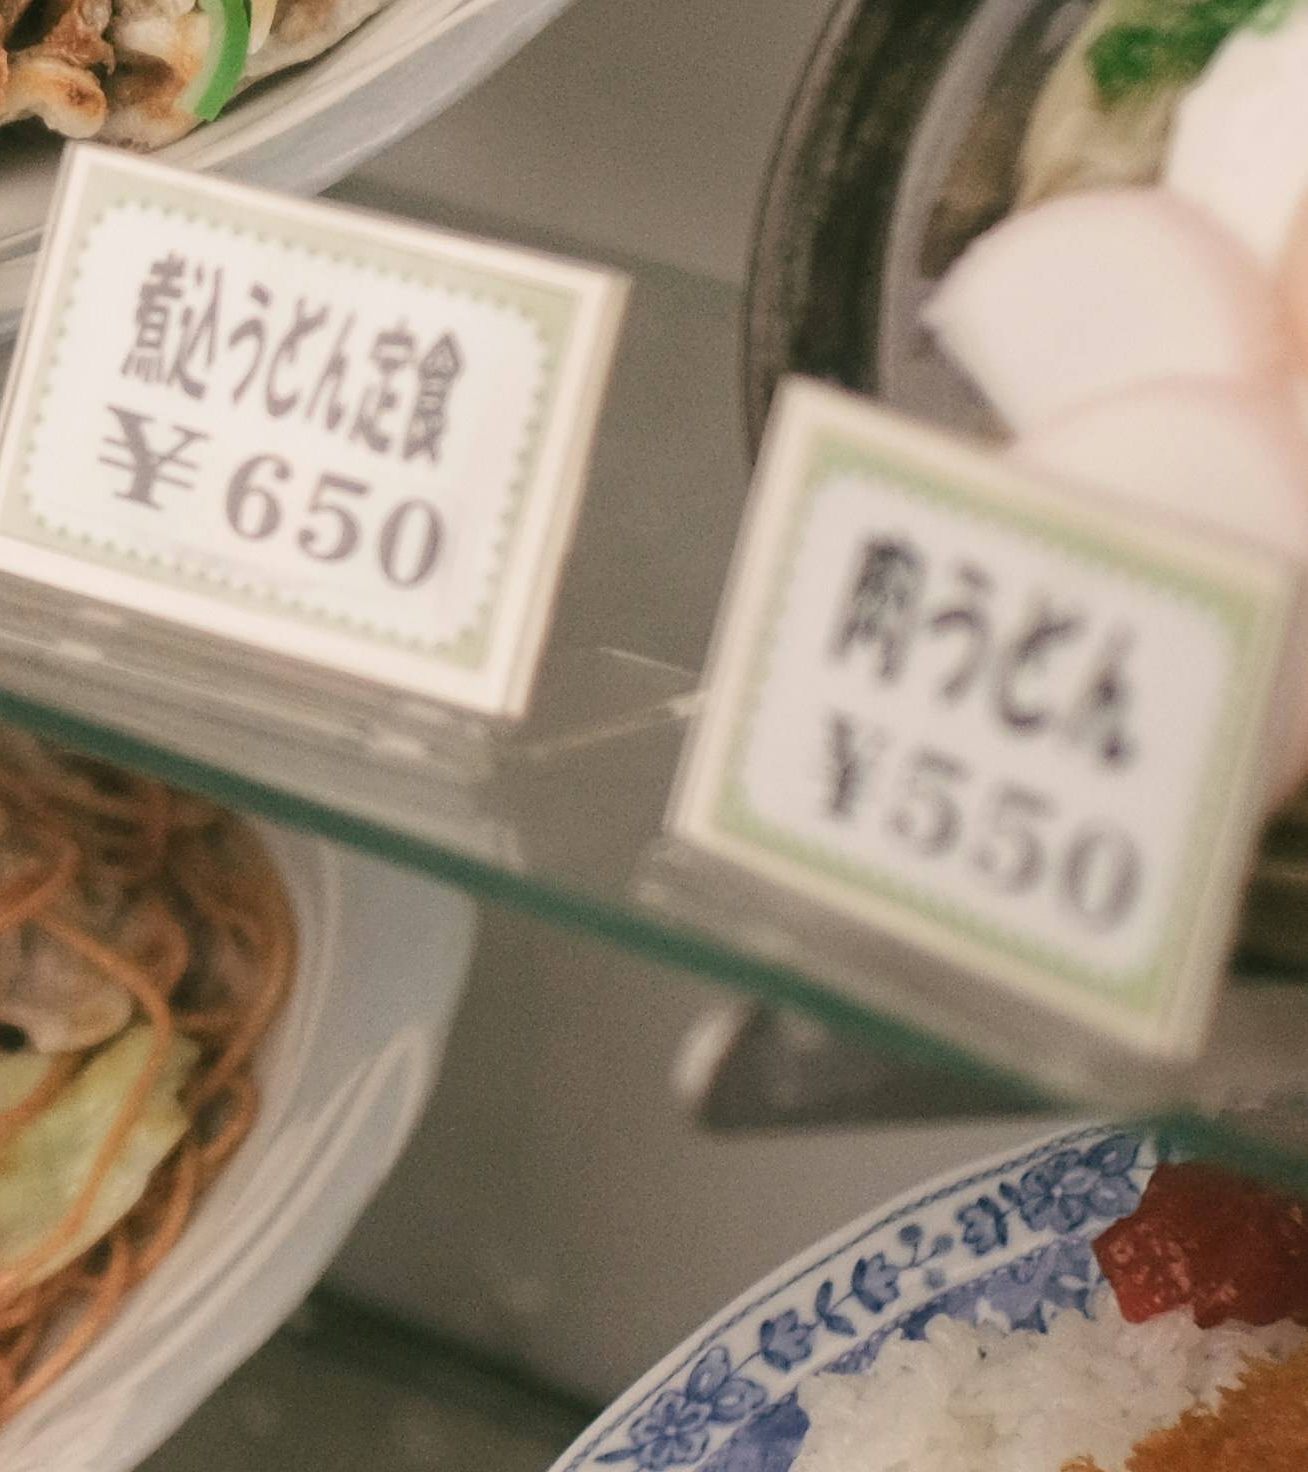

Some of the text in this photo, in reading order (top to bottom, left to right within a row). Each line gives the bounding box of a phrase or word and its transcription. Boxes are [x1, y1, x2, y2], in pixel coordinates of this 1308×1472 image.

[119, 250, 466, 468] 煮込うどん定食
[96, 404, 448, 591] ¥650
[829, 531, 1136, 770] 肉うどん
[822, 711, 1146, 936] ¥550
